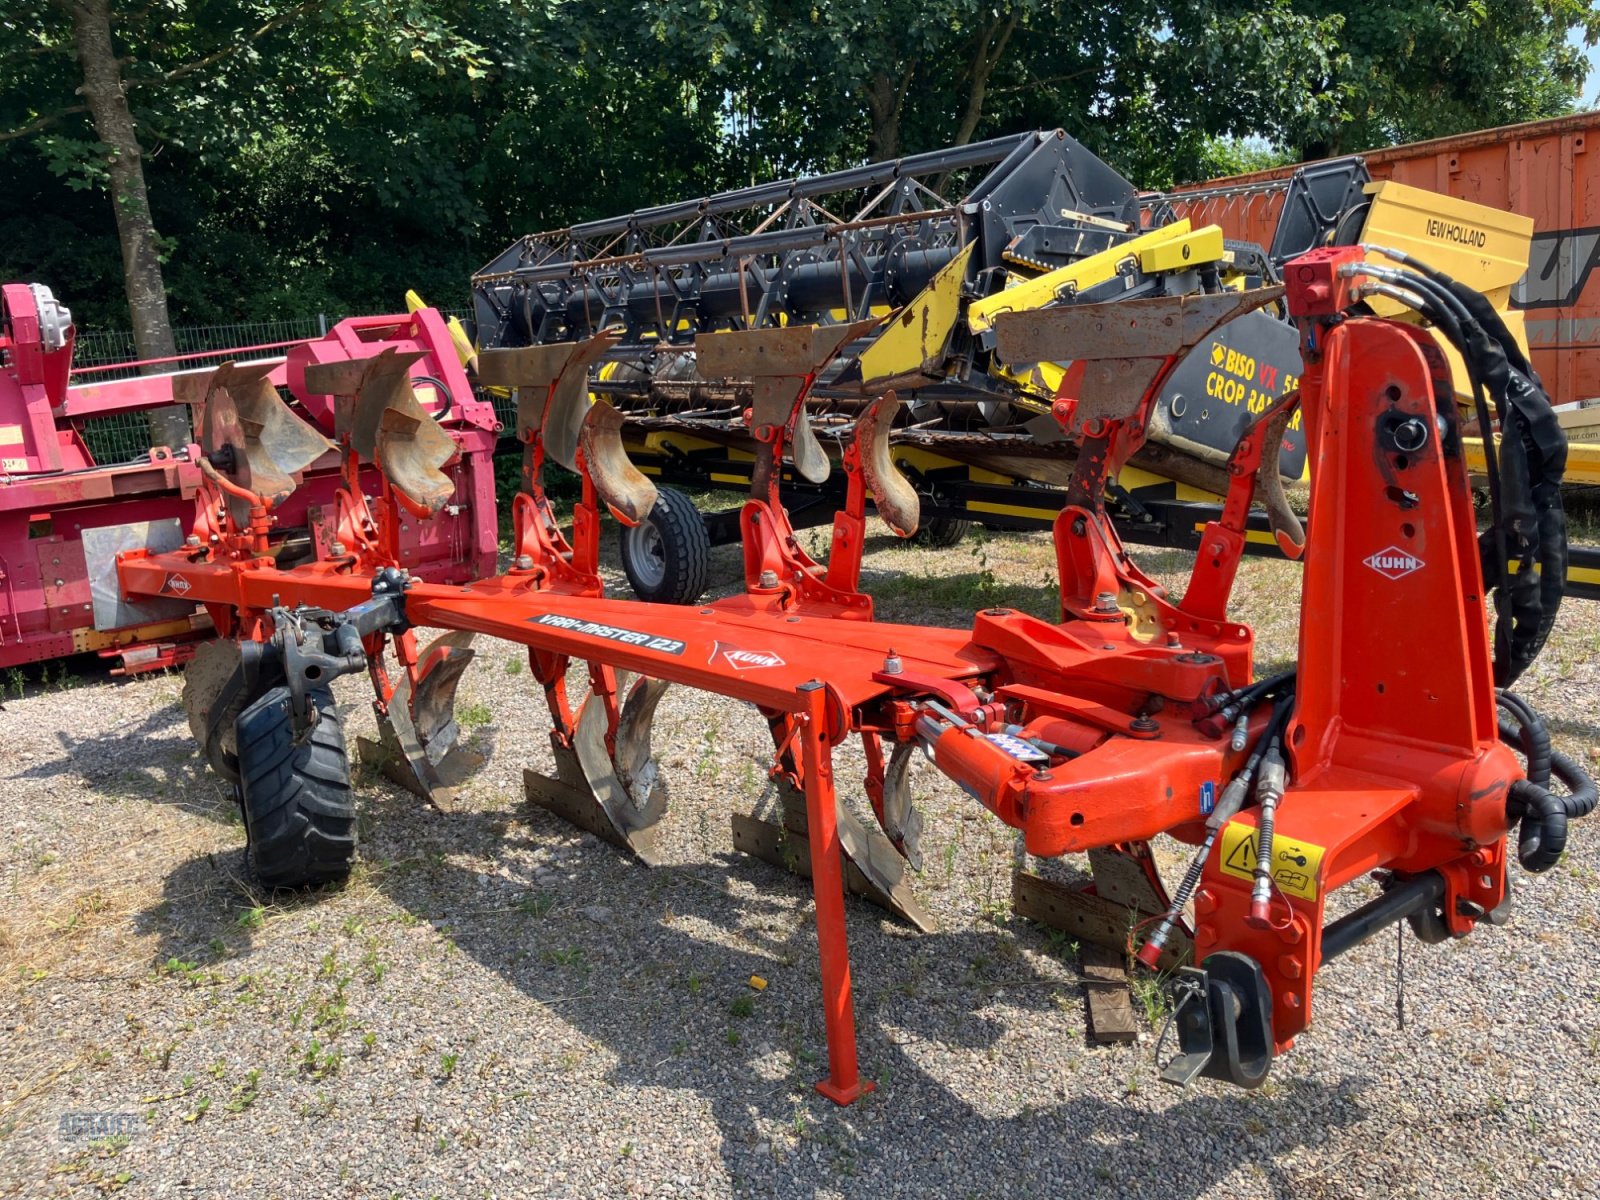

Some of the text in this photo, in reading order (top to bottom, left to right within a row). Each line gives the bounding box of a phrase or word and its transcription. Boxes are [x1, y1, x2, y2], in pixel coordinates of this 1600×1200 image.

[1426, 218, 1486, 248] NEW HOLLAND
[1225, 348, 1255, 380] BISO
[1259, 362, 1278, 392] VX
[1206, 371, 1246, 406] CROP
[1371, 556, 1416, 569] KUHN
[539, 614, 684, 652] VARI-MASTER 123
[729, 651, 778, 666] KUHN
